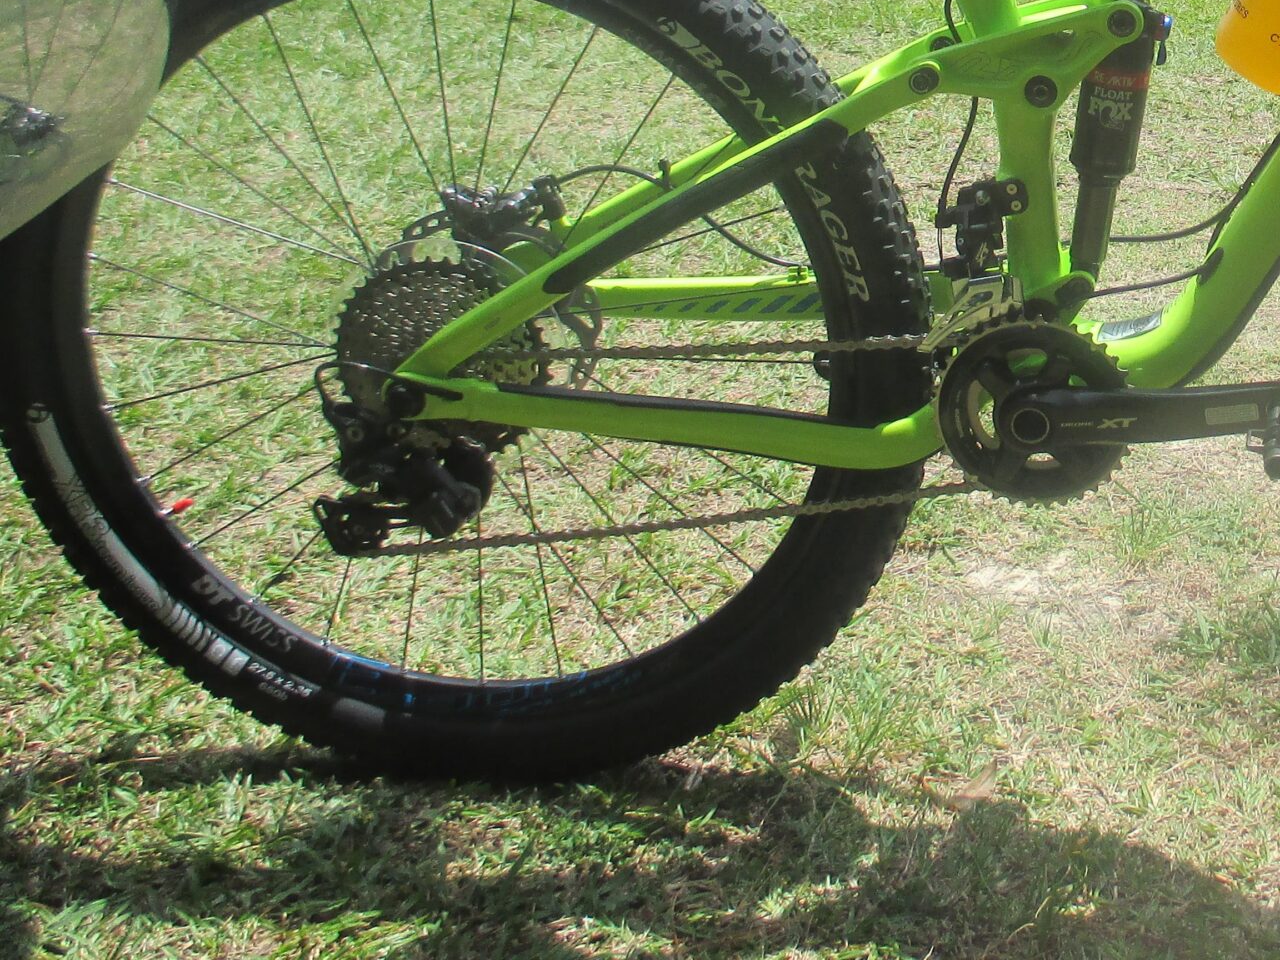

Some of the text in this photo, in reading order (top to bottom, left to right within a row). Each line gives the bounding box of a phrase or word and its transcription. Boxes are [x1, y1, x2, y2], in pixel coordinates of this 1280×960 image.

[1094, 86, 1133, 100] FLOAT
[1088, 96, 1134, 124] FOX
[1097, 417, 1137, 429] XT
[192, 574, 298, 653] DT SWISS
